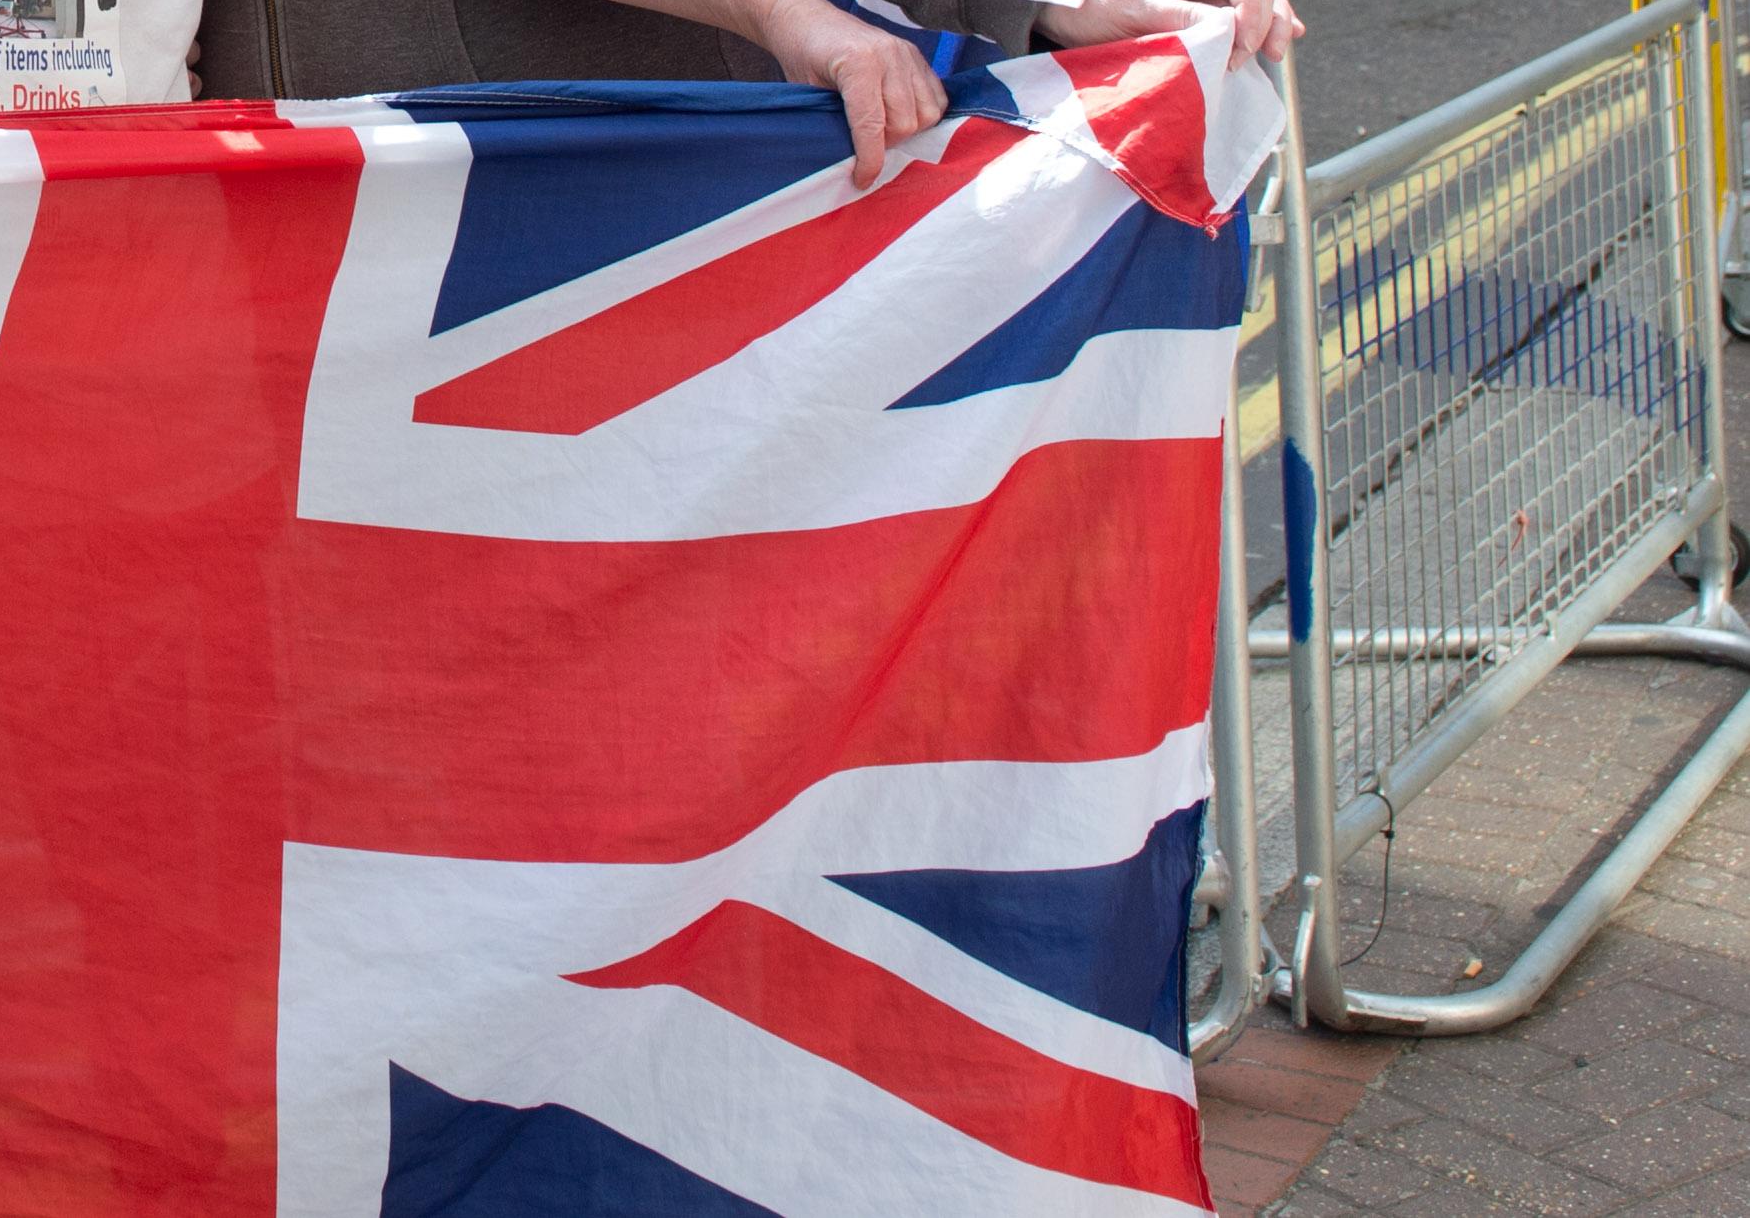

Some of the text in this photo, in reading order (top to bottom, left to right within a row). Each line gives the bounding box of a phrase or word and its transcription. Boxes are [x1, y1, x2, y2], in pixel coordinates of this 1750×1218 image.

[5, 41, 49, 71] items
[52, 40, 114, 77] including
[13, 83, 82, 110] Drinks
